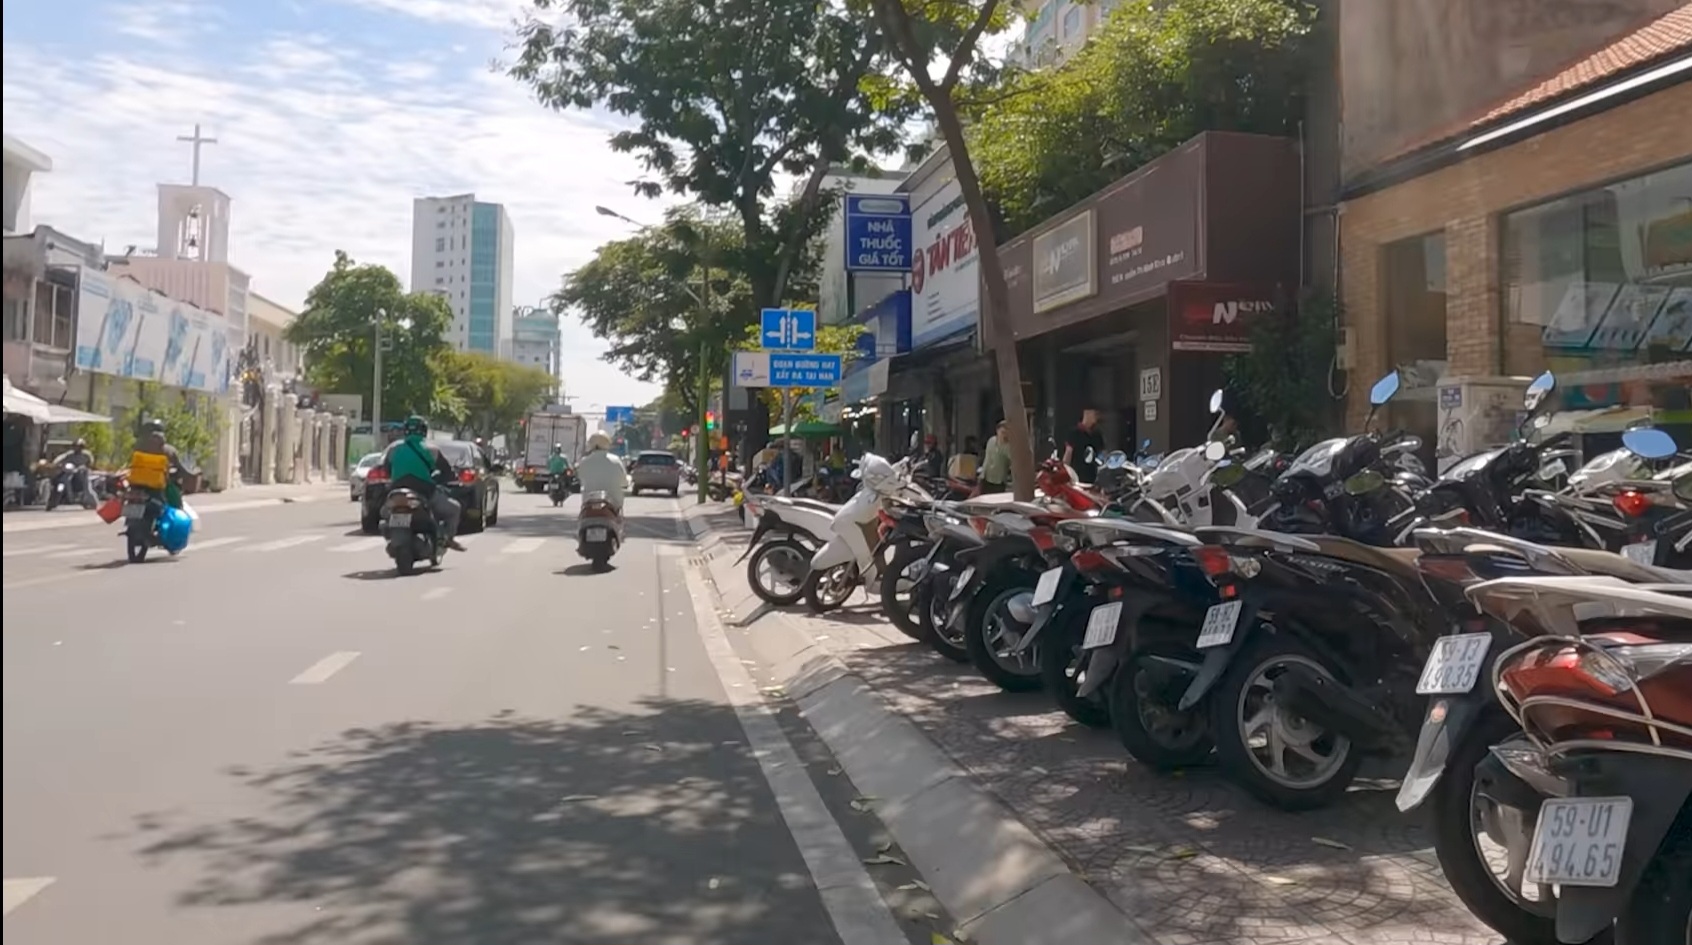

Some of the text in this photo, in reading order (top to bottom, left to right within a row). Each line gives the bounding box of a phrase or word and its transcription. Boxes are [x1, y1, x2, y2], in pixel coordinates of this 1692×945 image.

[859, 234, 903, 250] THUỐC
[858, 249, 905, 266] GIÁ TỐT
[1142, 374, 1160, 394] 15E
[1551, 804, 1615, 838] 59-U1
[1534, 842, 1617, 878] 494.65
